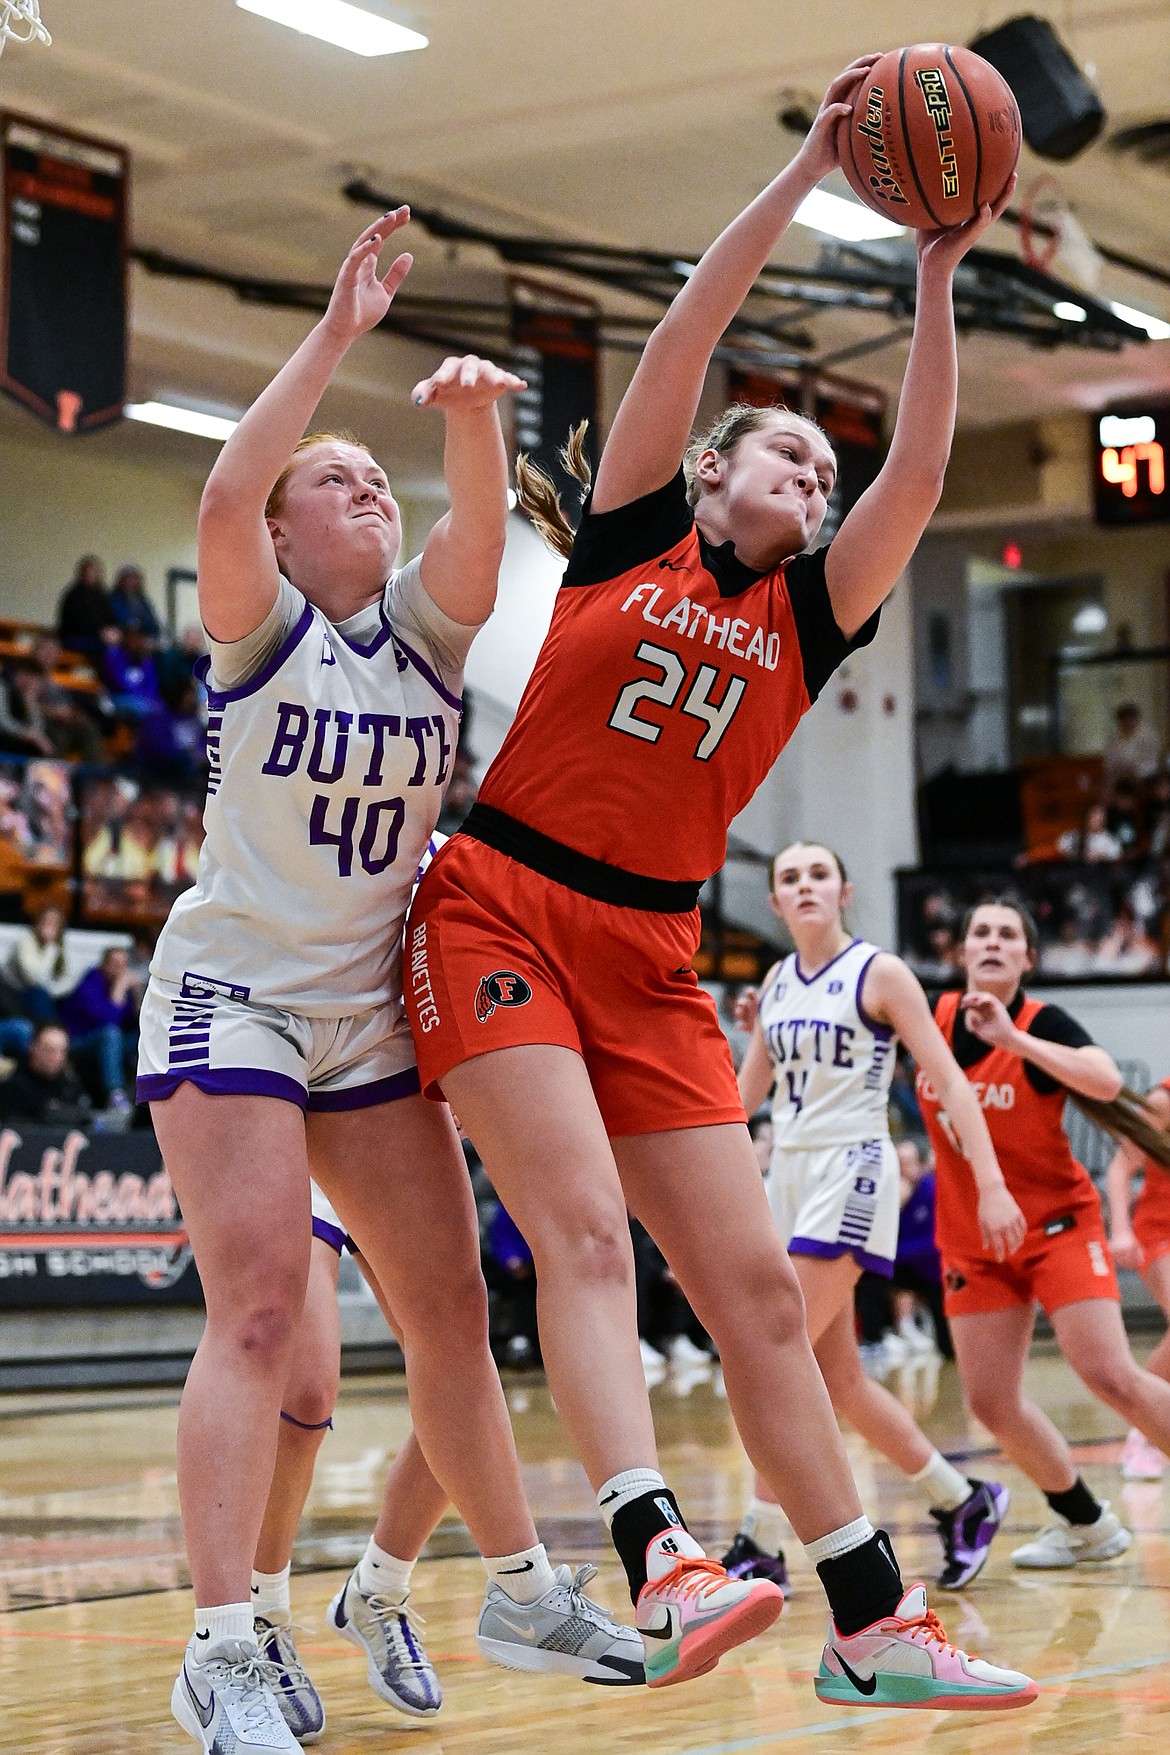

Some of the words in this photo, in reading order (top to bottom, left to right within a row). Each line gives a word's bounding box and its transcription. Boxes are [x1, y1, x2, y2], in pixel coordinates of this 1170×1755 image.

[858, 86, 910, 205] Baden
[1102, 441, 1165, 498] 47
[620, 583, 781, 672] FLATHEAD
[606, 639, 748, 762] 24
[309, 794, 405, 877] 40
[411, 921, 440, 1033] BRAVETTES
[768, 1019, 856, 1068] UTTE
[0, 1128, 178, 1223] lathead
